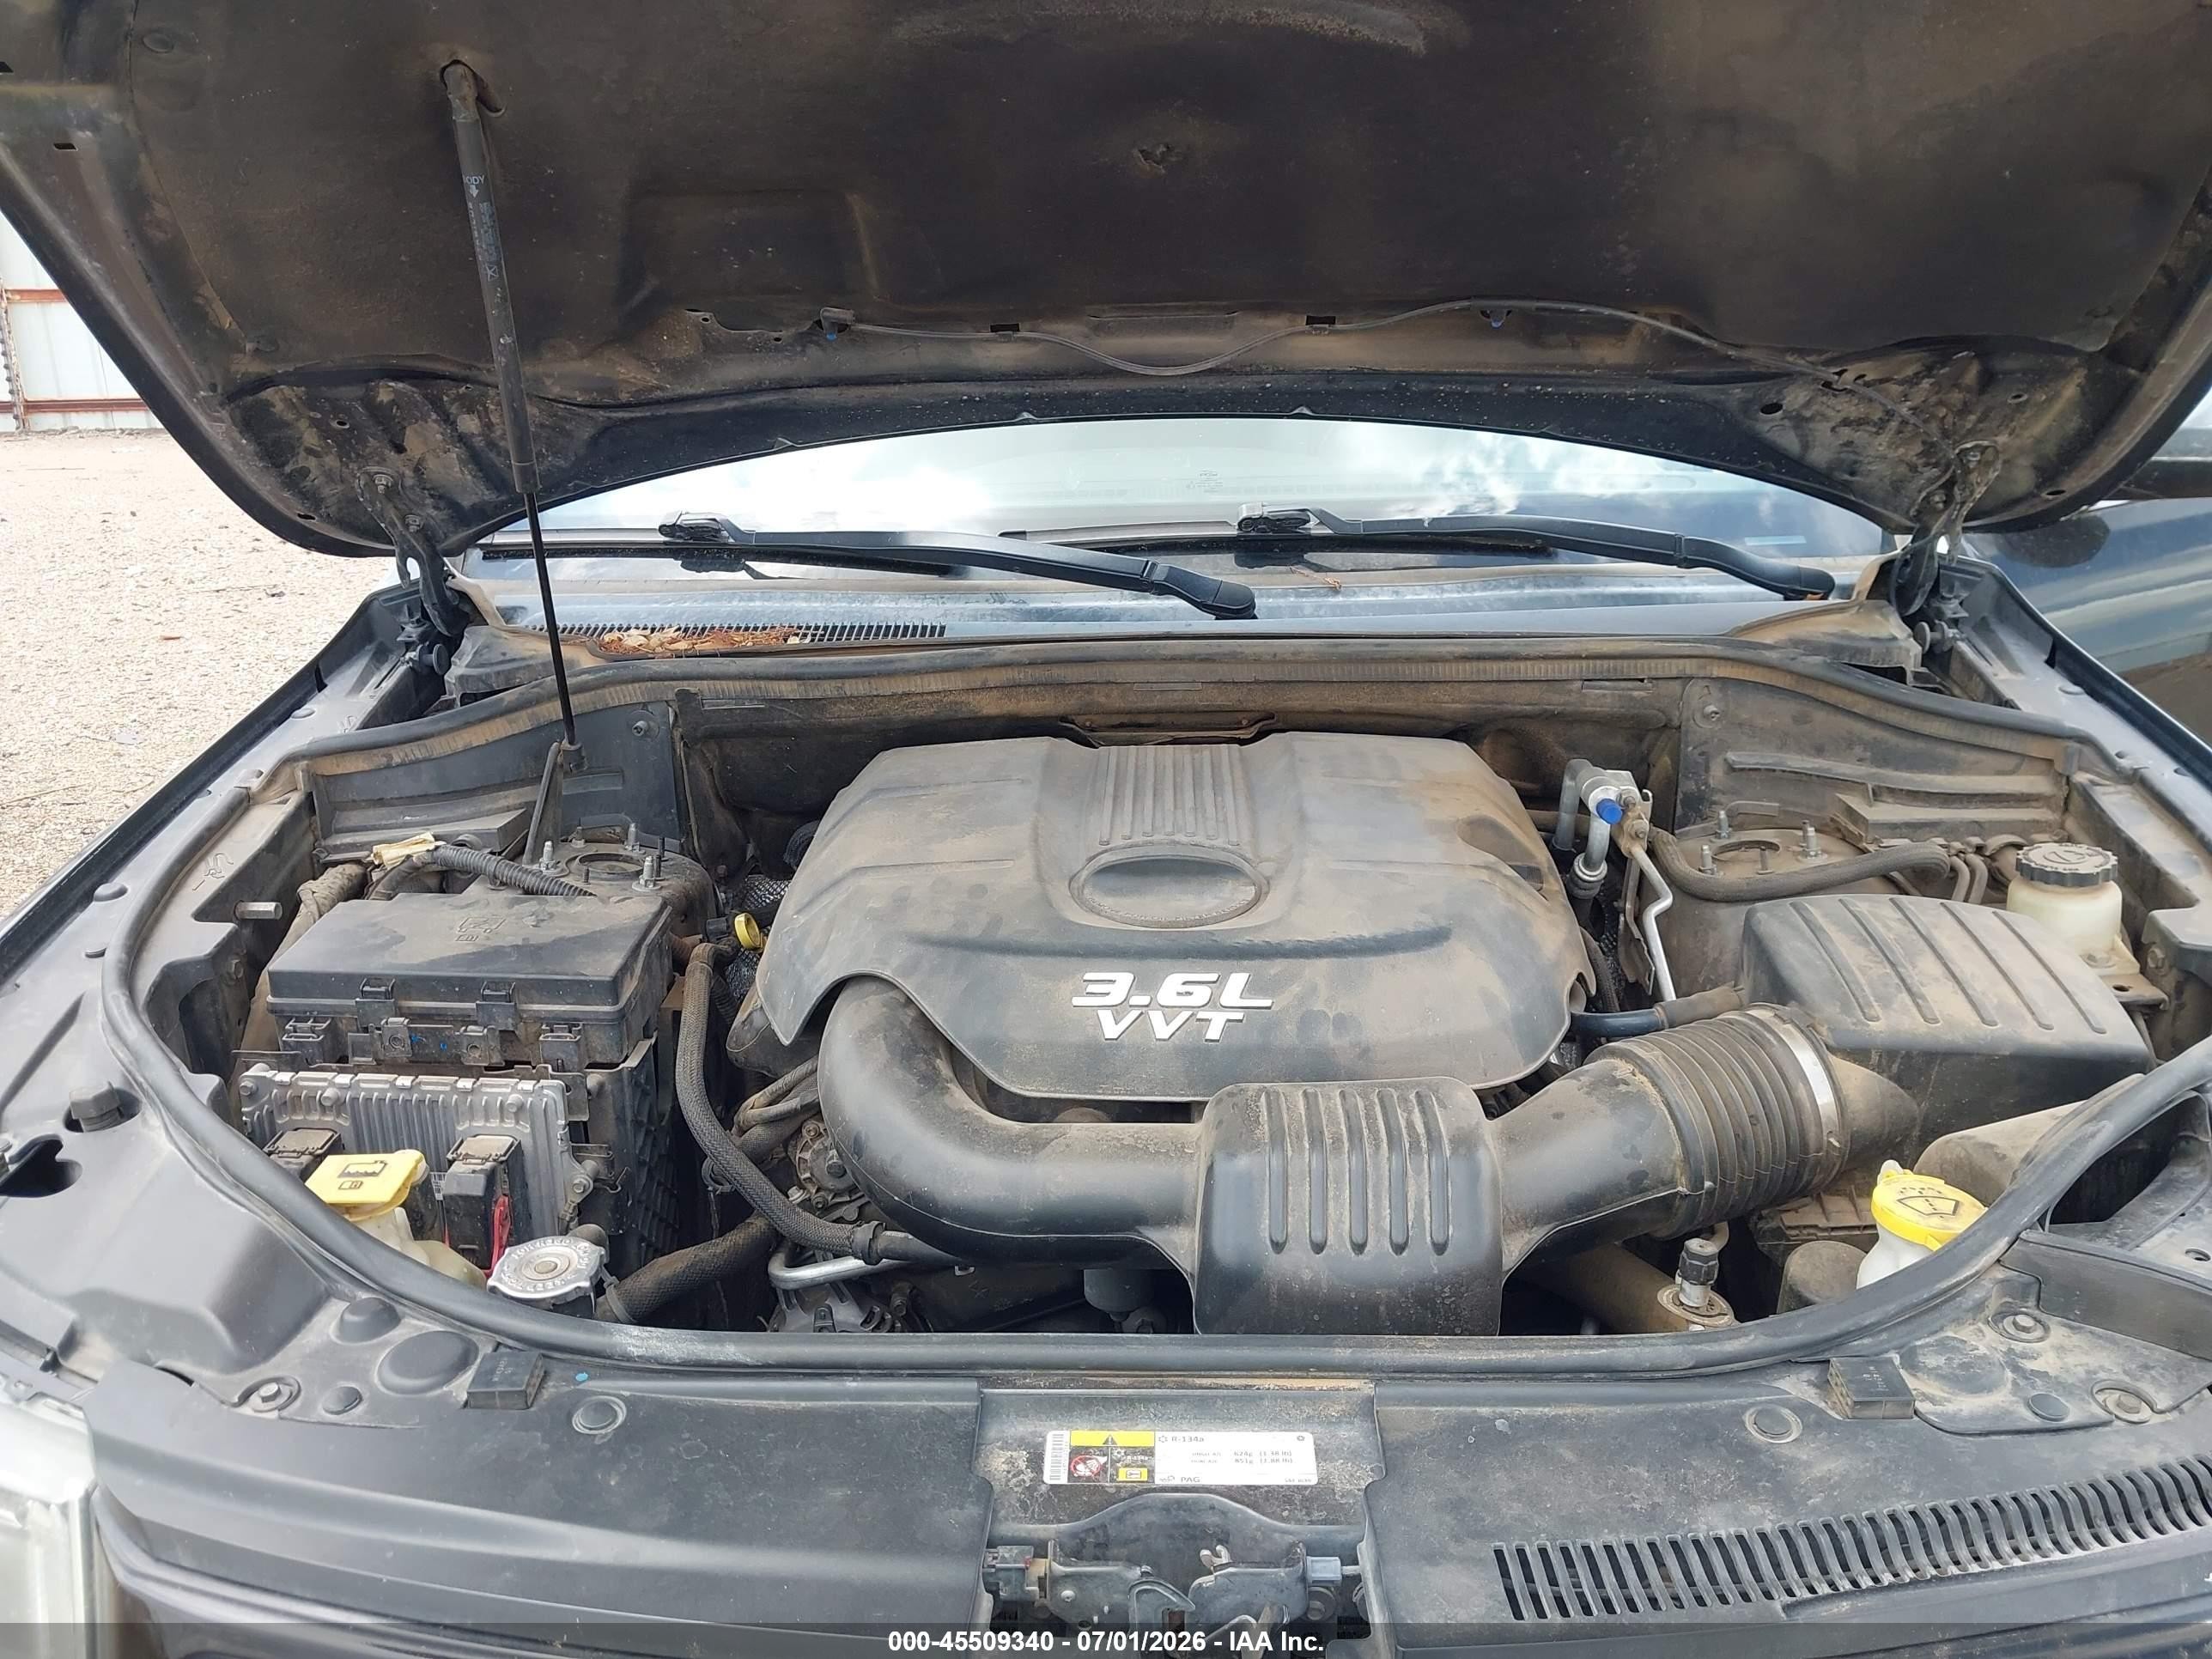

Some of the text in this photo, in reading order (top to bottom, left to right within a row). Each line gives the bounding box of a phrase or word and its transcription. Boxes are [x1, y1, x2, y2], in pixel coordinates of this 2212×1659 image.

[463, 174, 485, 185] ODY
[1072, 971, 1274, 1010] 3.6L
[1096, 1008, 1245, 1042] VVT
